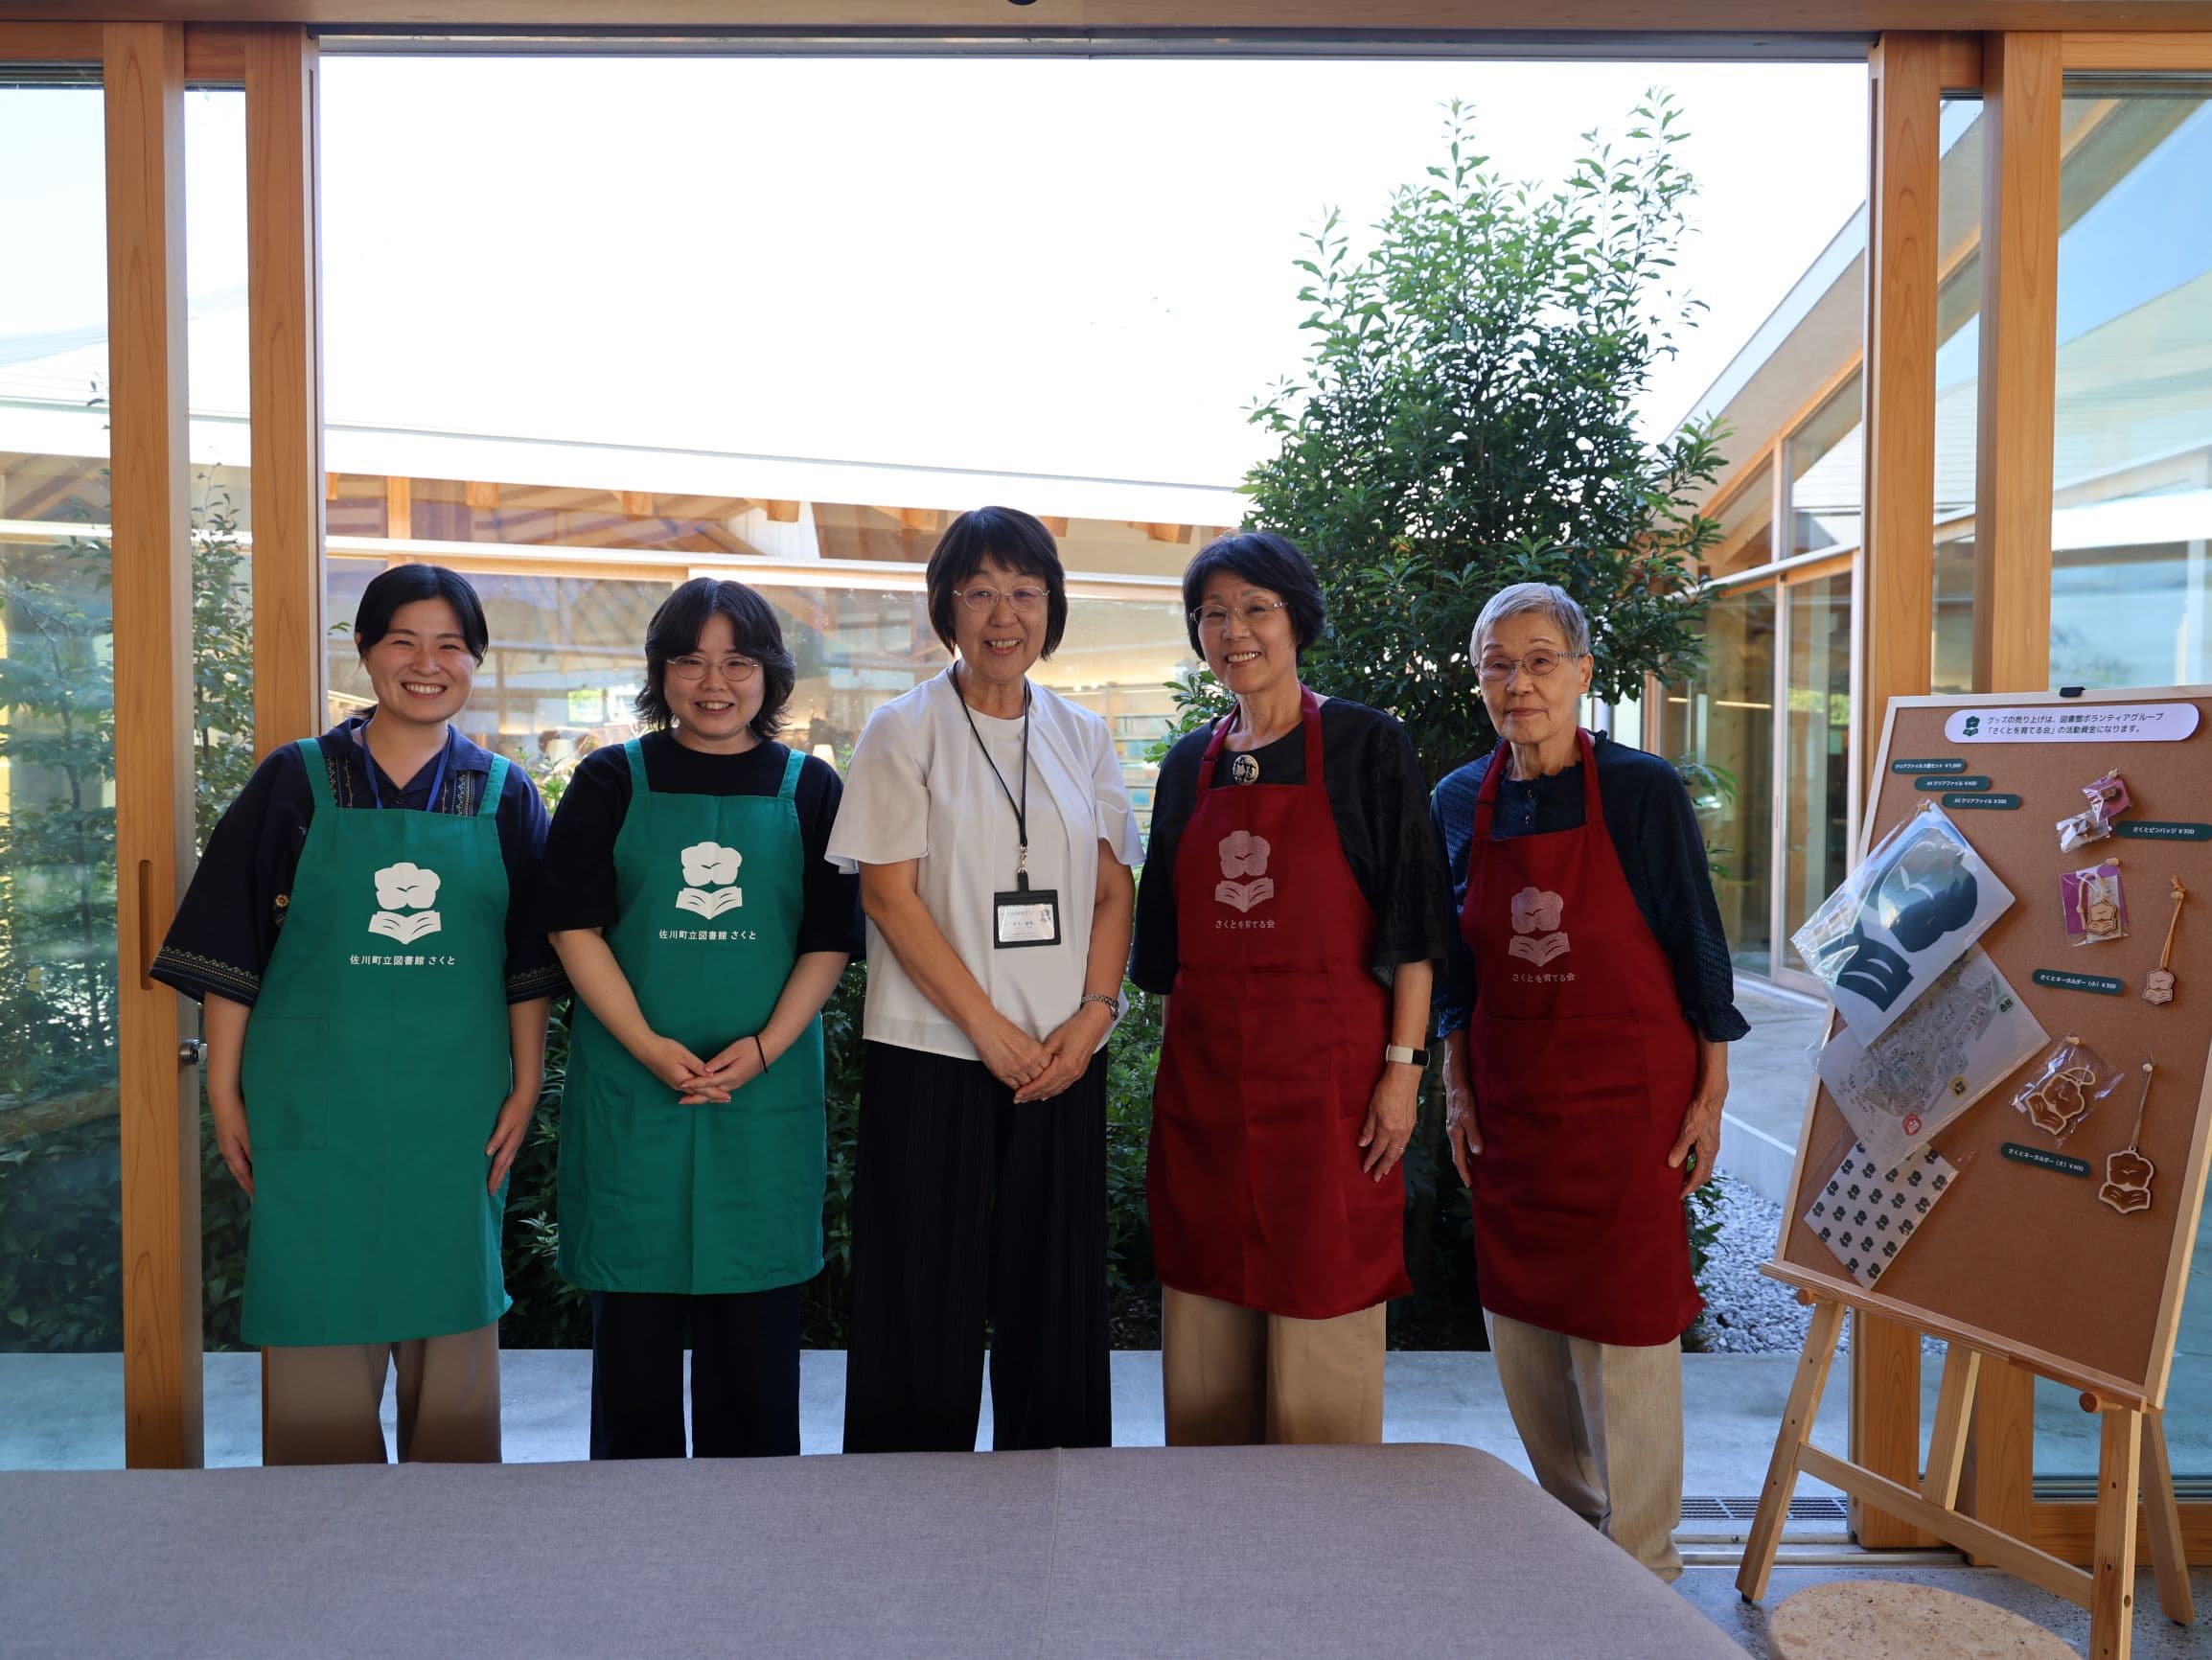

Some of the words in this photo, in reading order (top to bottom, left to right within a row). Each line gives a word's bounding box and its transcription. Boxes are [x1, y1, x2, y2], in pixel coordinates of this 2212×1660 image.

[658, 929, 727, 940] 佐川町立図書館
[730, 930, 757, 940] さくと
[349, 954, 426, 966] 佐川町立図書館
[427, 956, 456, 965] さくと
[1511, 972, 1576, 983] さくとを育てる会
